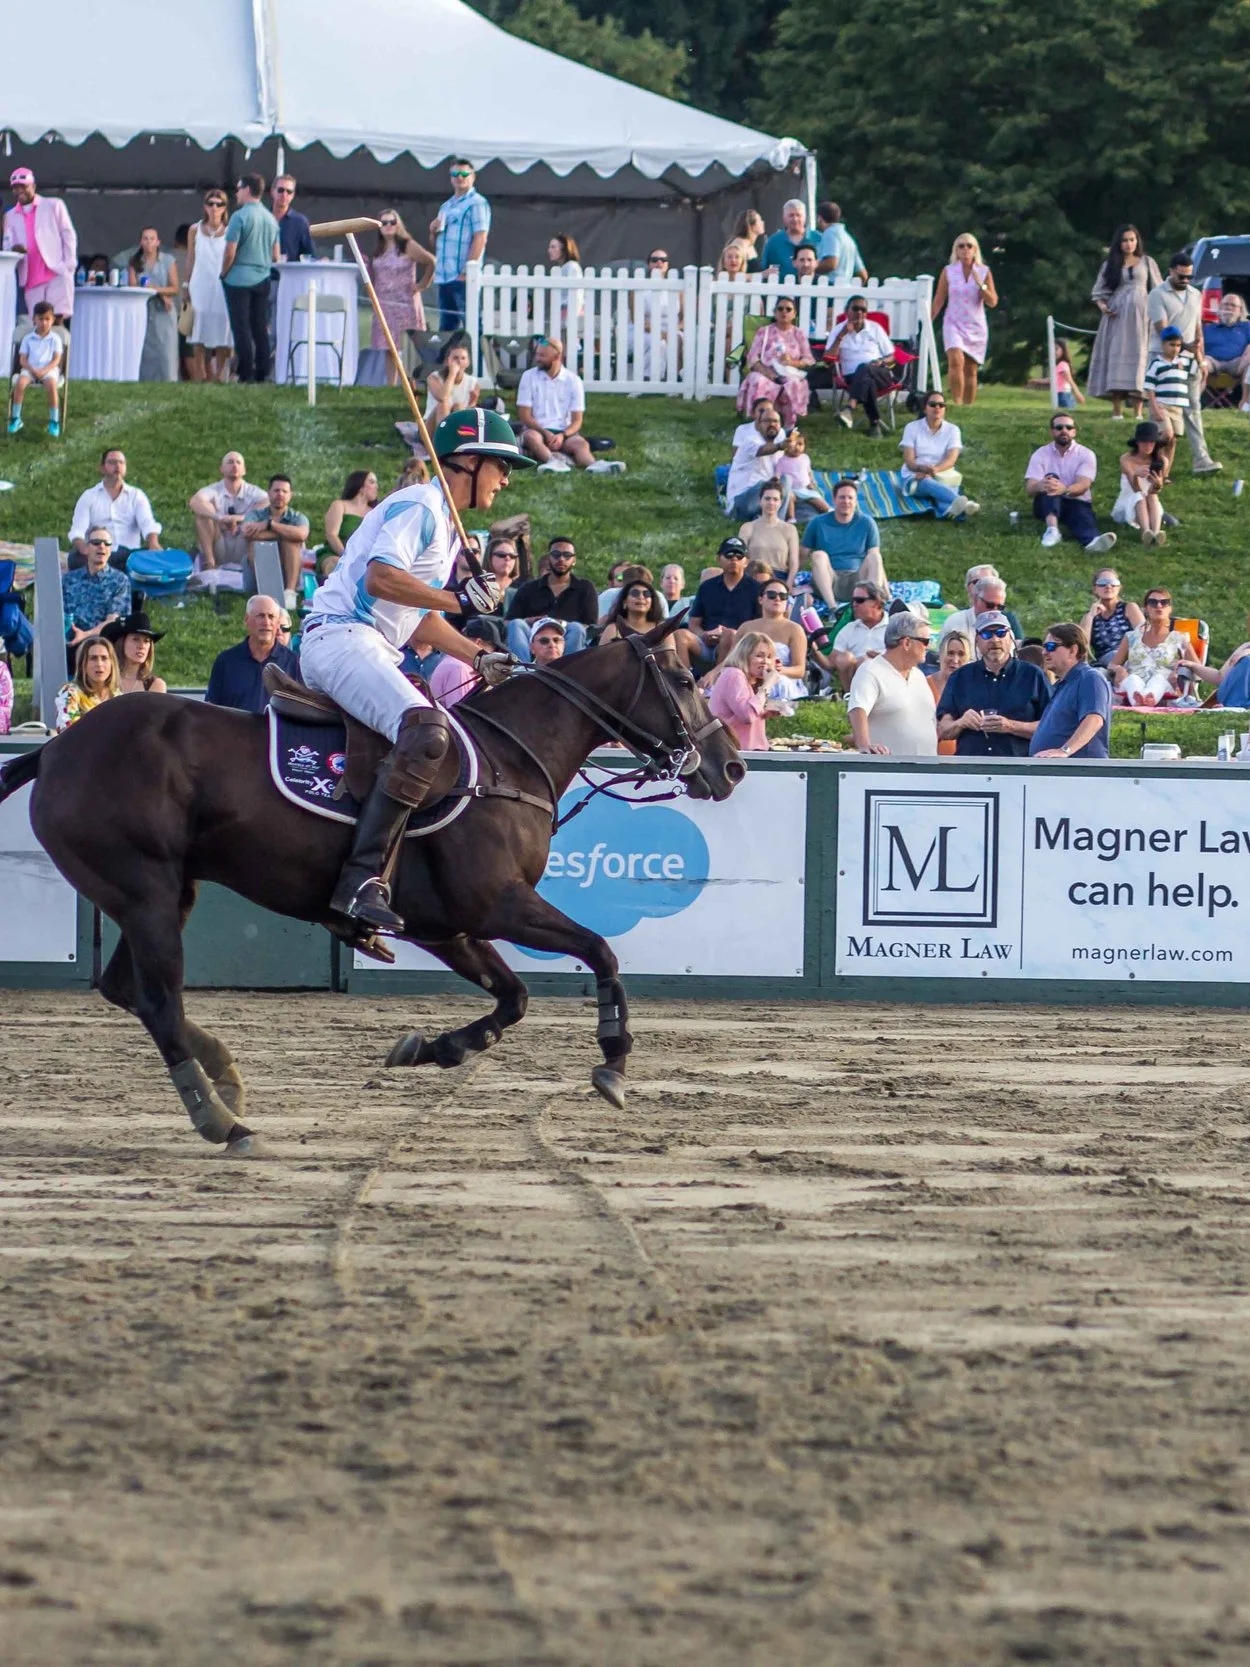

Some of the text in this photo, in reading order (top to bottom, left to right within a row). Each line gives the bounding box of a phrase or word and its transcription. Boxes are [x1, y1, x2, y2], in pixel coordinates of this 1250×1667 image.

[880, 825, 979, 893] ML
[1034, 816, 1187, 861] Magner
[545, 843, 685, 888] esforce
[1068, 872, 1239, 918] can help.
[846, 936, 1013, 960] MAGNER LAW
[1071, 943, 1233, 965] magnerlaw.com
